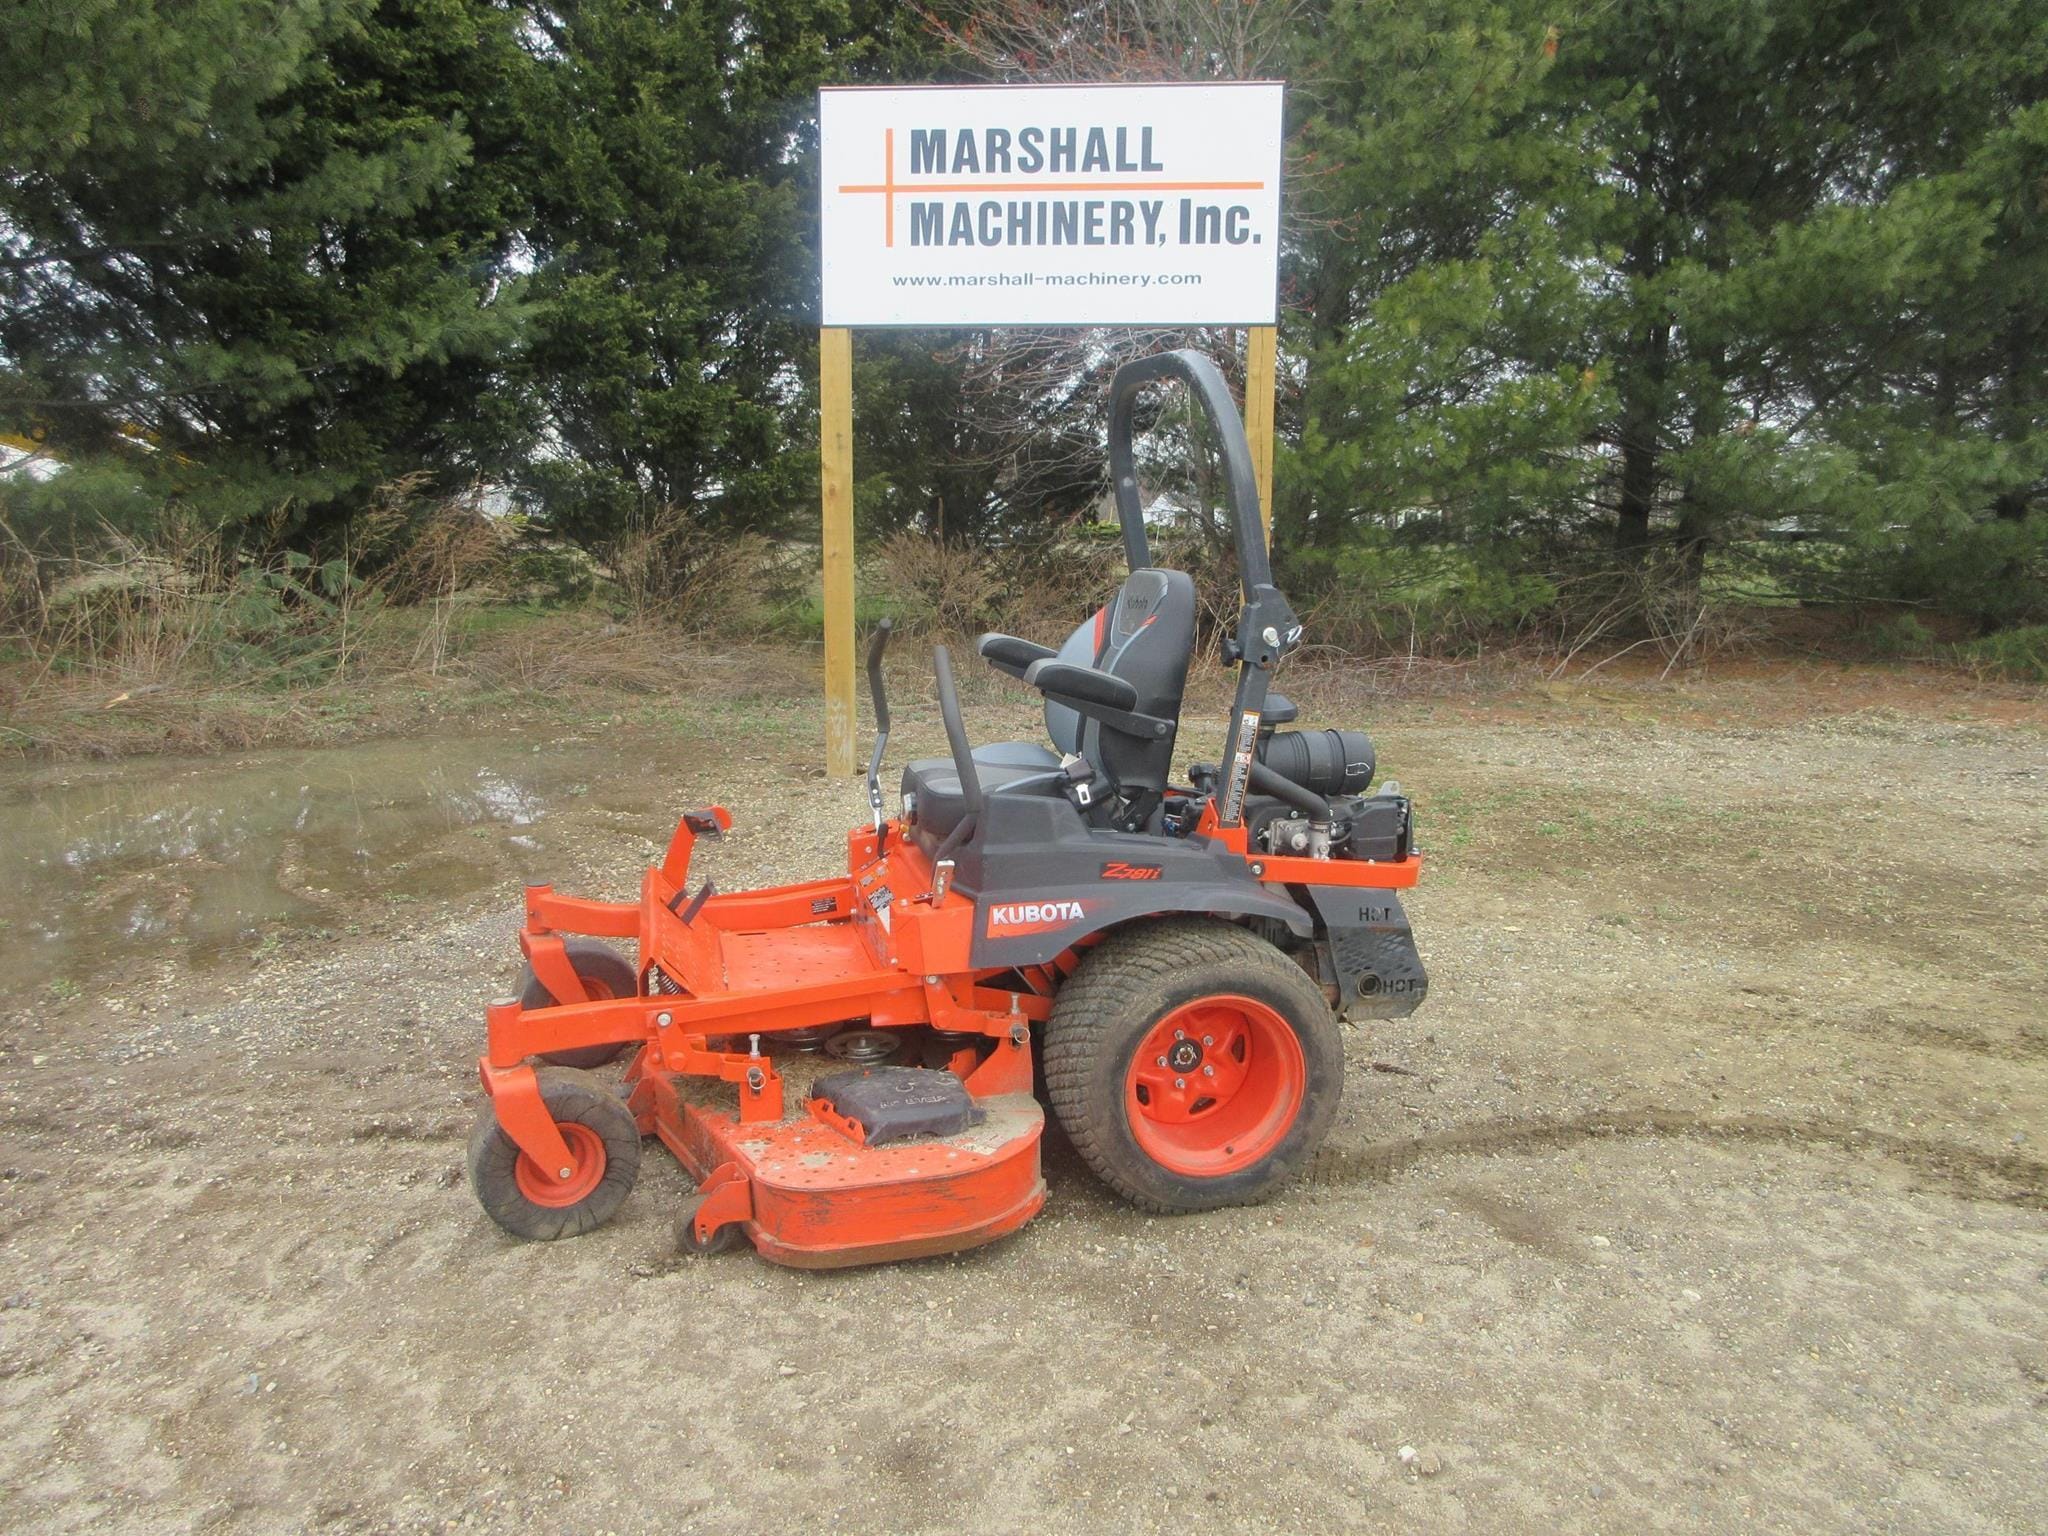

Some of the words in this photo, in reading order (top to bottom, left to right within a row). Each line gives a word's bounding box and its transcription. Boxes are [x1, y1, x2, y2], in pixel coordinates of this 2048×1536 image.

[910, 126, 1163, 174] MARSHALL
[910, 200, 1168, 248] MACHINERY,
[1178, 198, 1262, 245] Inc.
[892, 271, 1202, 287] www.marshall-machinery.com
[992, 902, 1085, 925] KUBOTA
[1382, 978, 1417, 994] HOT
